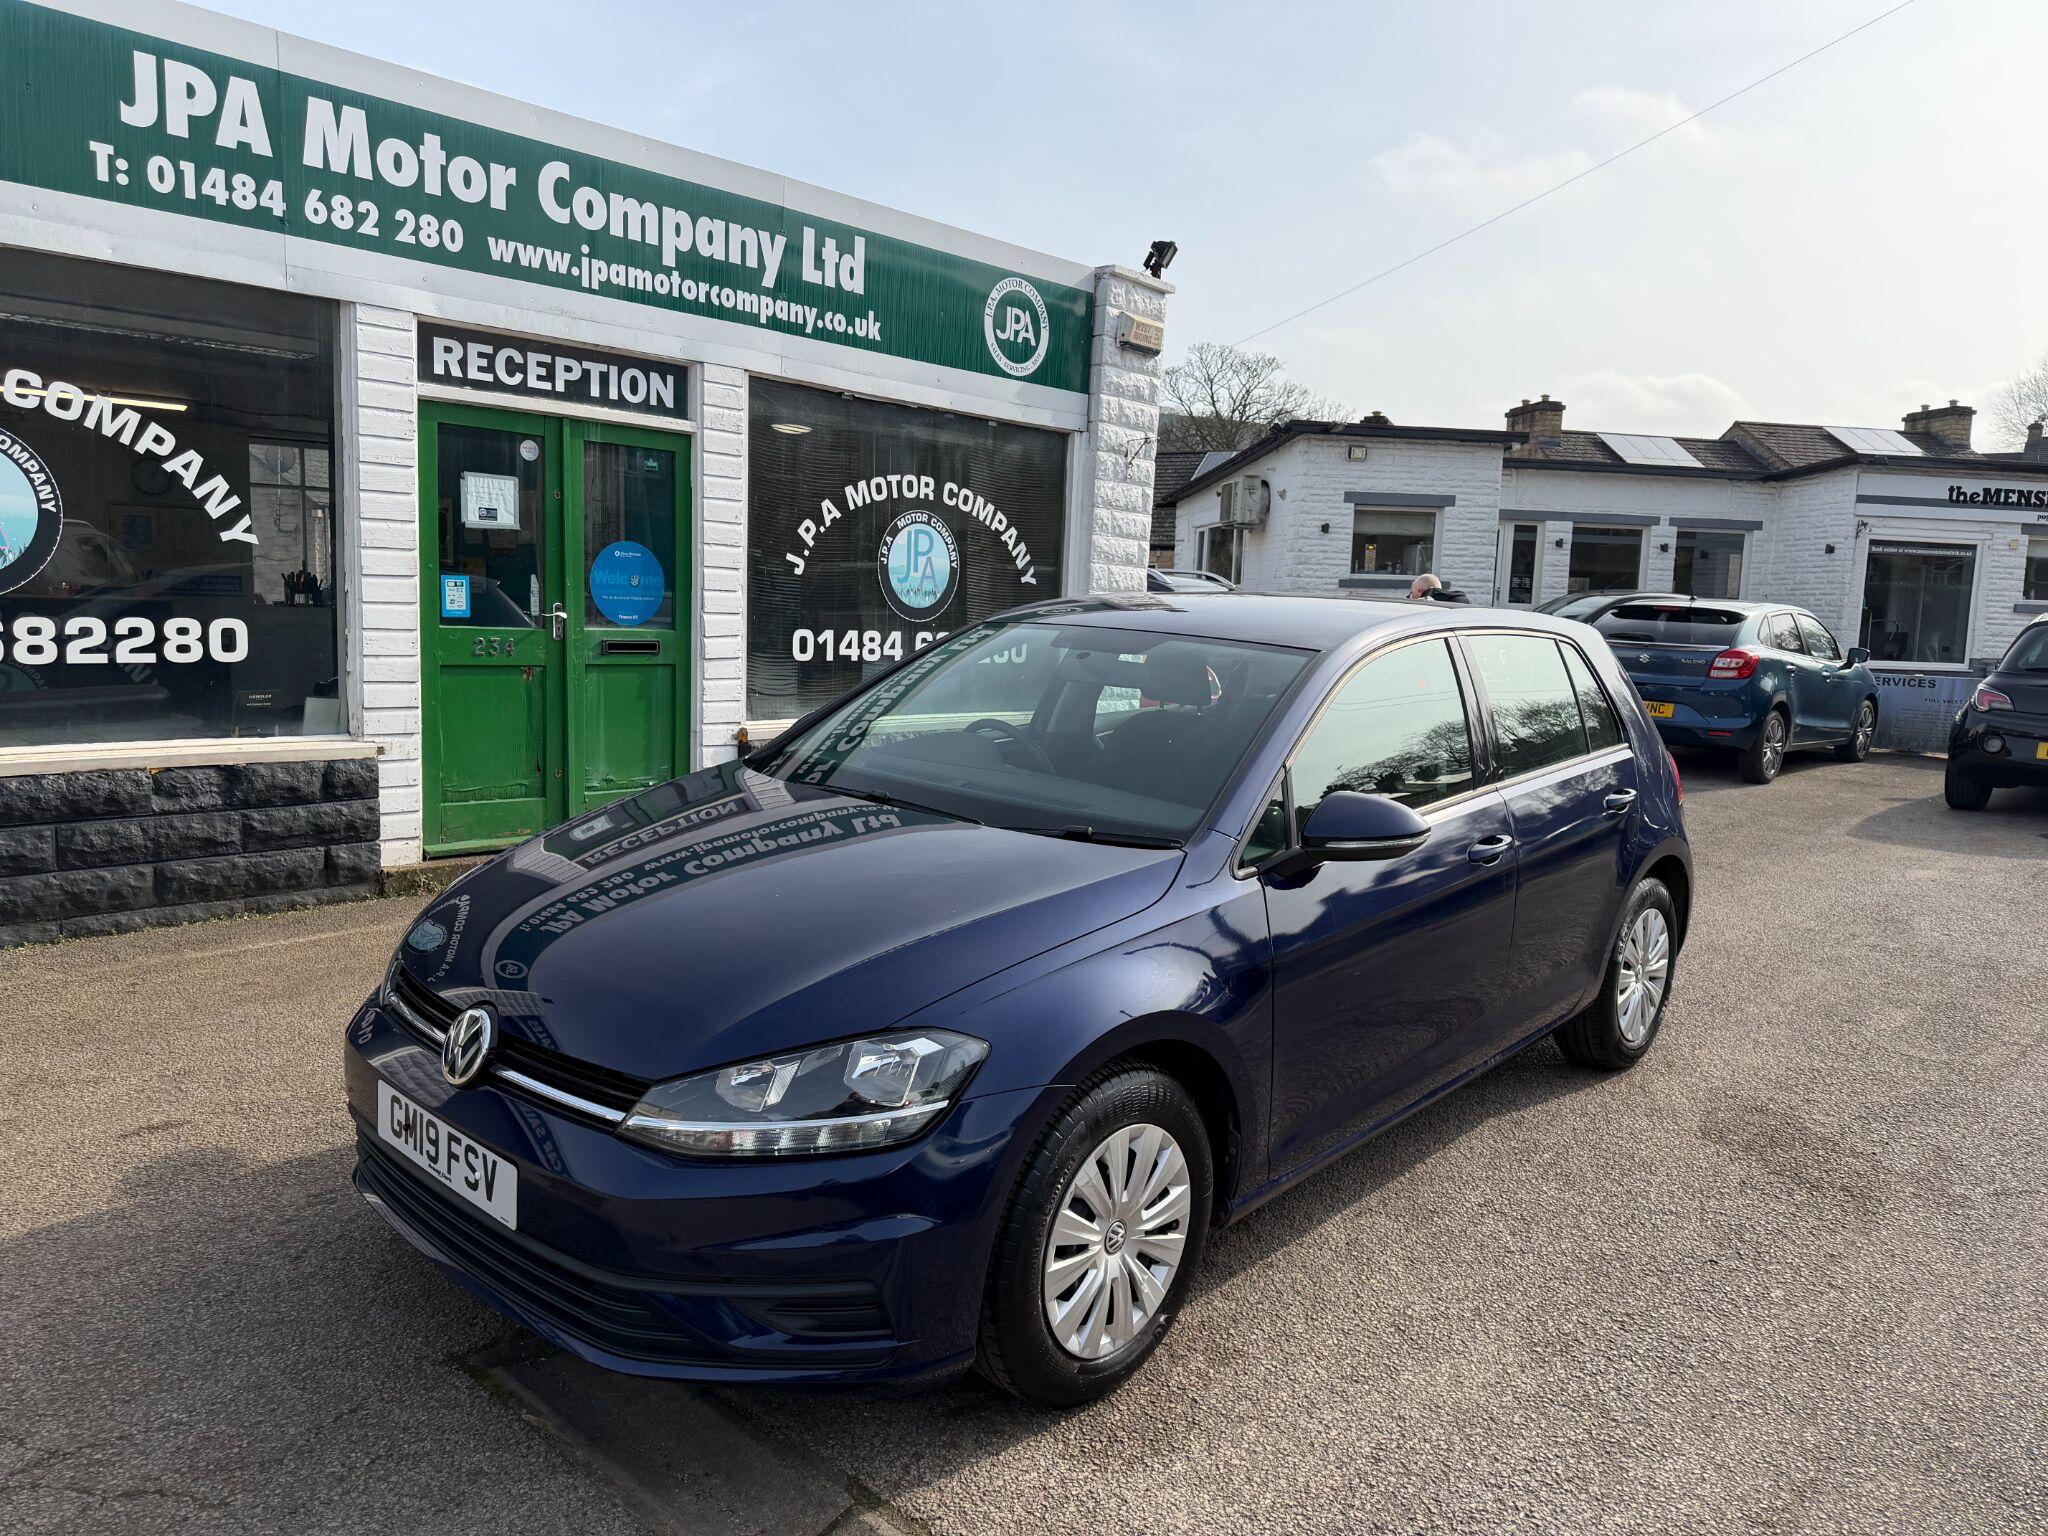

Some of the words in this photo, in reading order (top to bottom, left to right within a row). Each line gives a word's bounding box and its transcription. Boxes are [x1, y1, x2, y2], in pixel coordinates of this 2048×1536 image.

[120, 50, 273, 157] JPA
[302, 96, 517, 210] Motor
[538, 161, 787, 288] Company
[802, 226, 865, 296] Ltd
[89, 141, 129, 186] T:
[147, 155, 286, 217] 01484
[304, 189, 379, 237] 682
[394, 208, 464, 253] 280
[487, 236, 881, 341] www.jpamotorcompany.co.uk
[995, 306, 1036, 347] JPA
[996, 279, 1023, 297] MOTOR
[1023, 280, 1049, 331] COMPANY
[433, 336, 674, 408] RECEPTION
[3, 369, 259, 545] COMPANY
[1948, 486, 2048, 508] theMENS
[844, 474, 935, 511] MOTOR
[943, 482, 1037, 585] COMPANY
[896, 513, 928, 529] MOTOR
[930, 519, 957, 568] COMPANY
[897, 529, 938, 592] JPA
[0, 617, 249, 664] 82280
[792, 629, 903, 663] 01484
[1874, 676, 1937, 688] ERVICES
[390, 1094, 439, 1165] GM19
[447, 1131, 498, 1202] FSV
